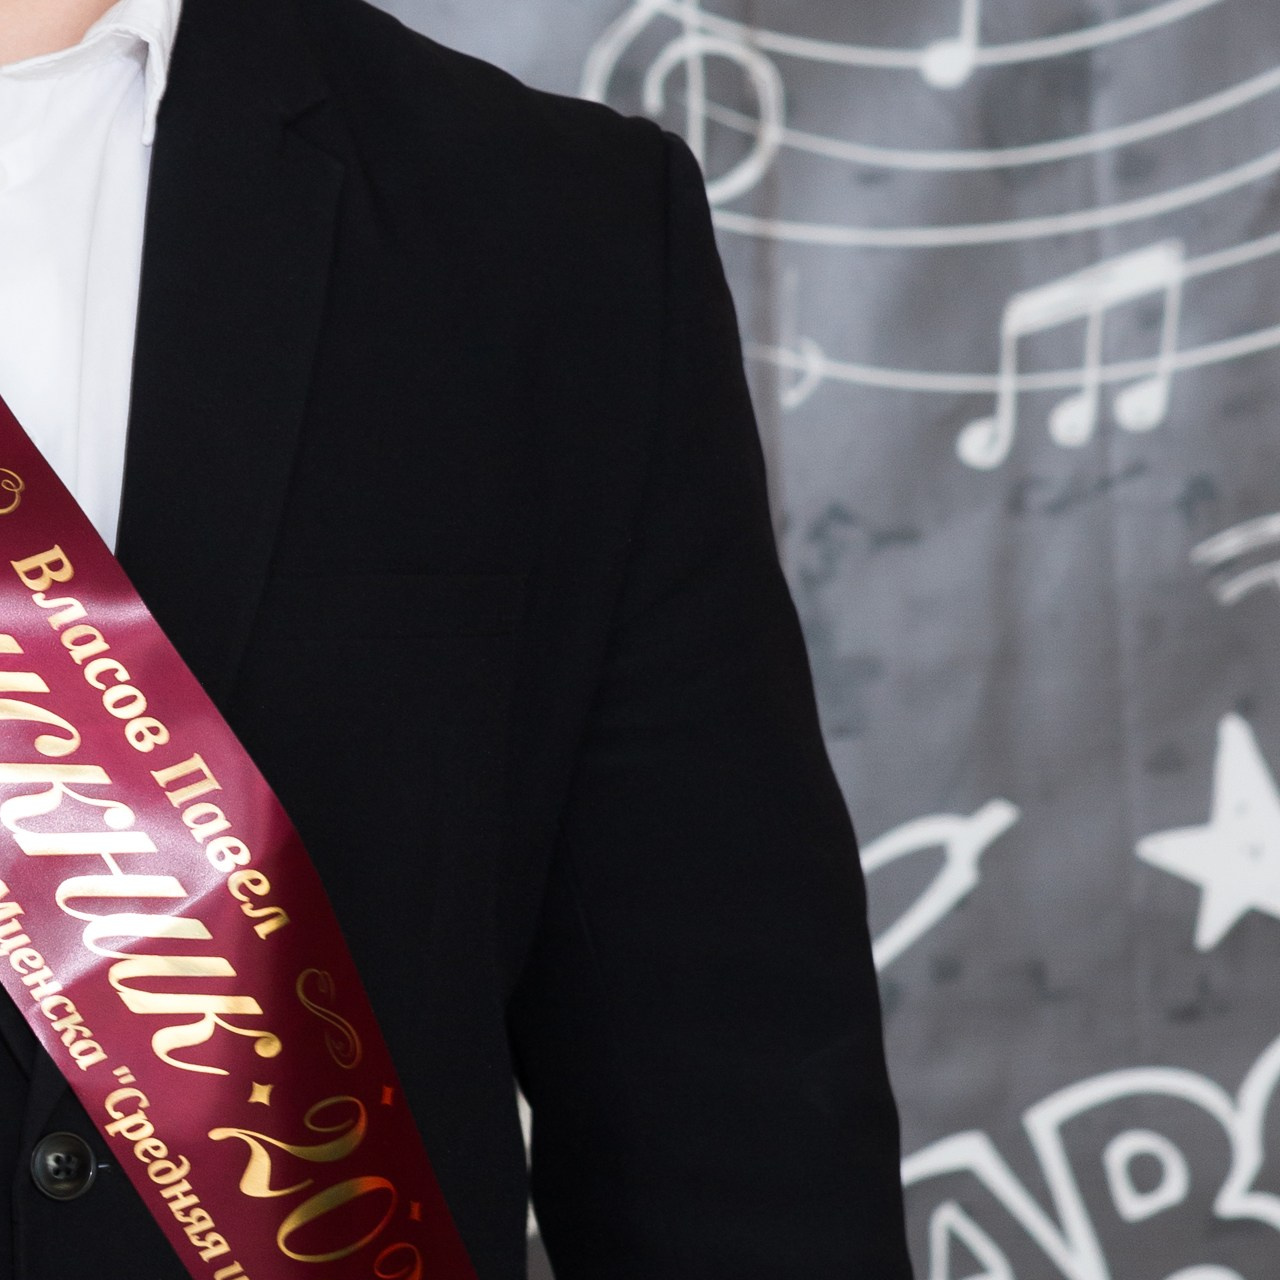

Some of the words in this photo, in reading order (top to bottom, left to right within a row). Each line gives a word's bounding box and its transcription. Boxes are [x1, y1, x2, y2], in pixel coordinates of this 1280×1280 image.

[10, 544, 170, 753] Власов
[150, 753, 291, 940] Павел
[104, 1065, 231, 1263] "Средняя
